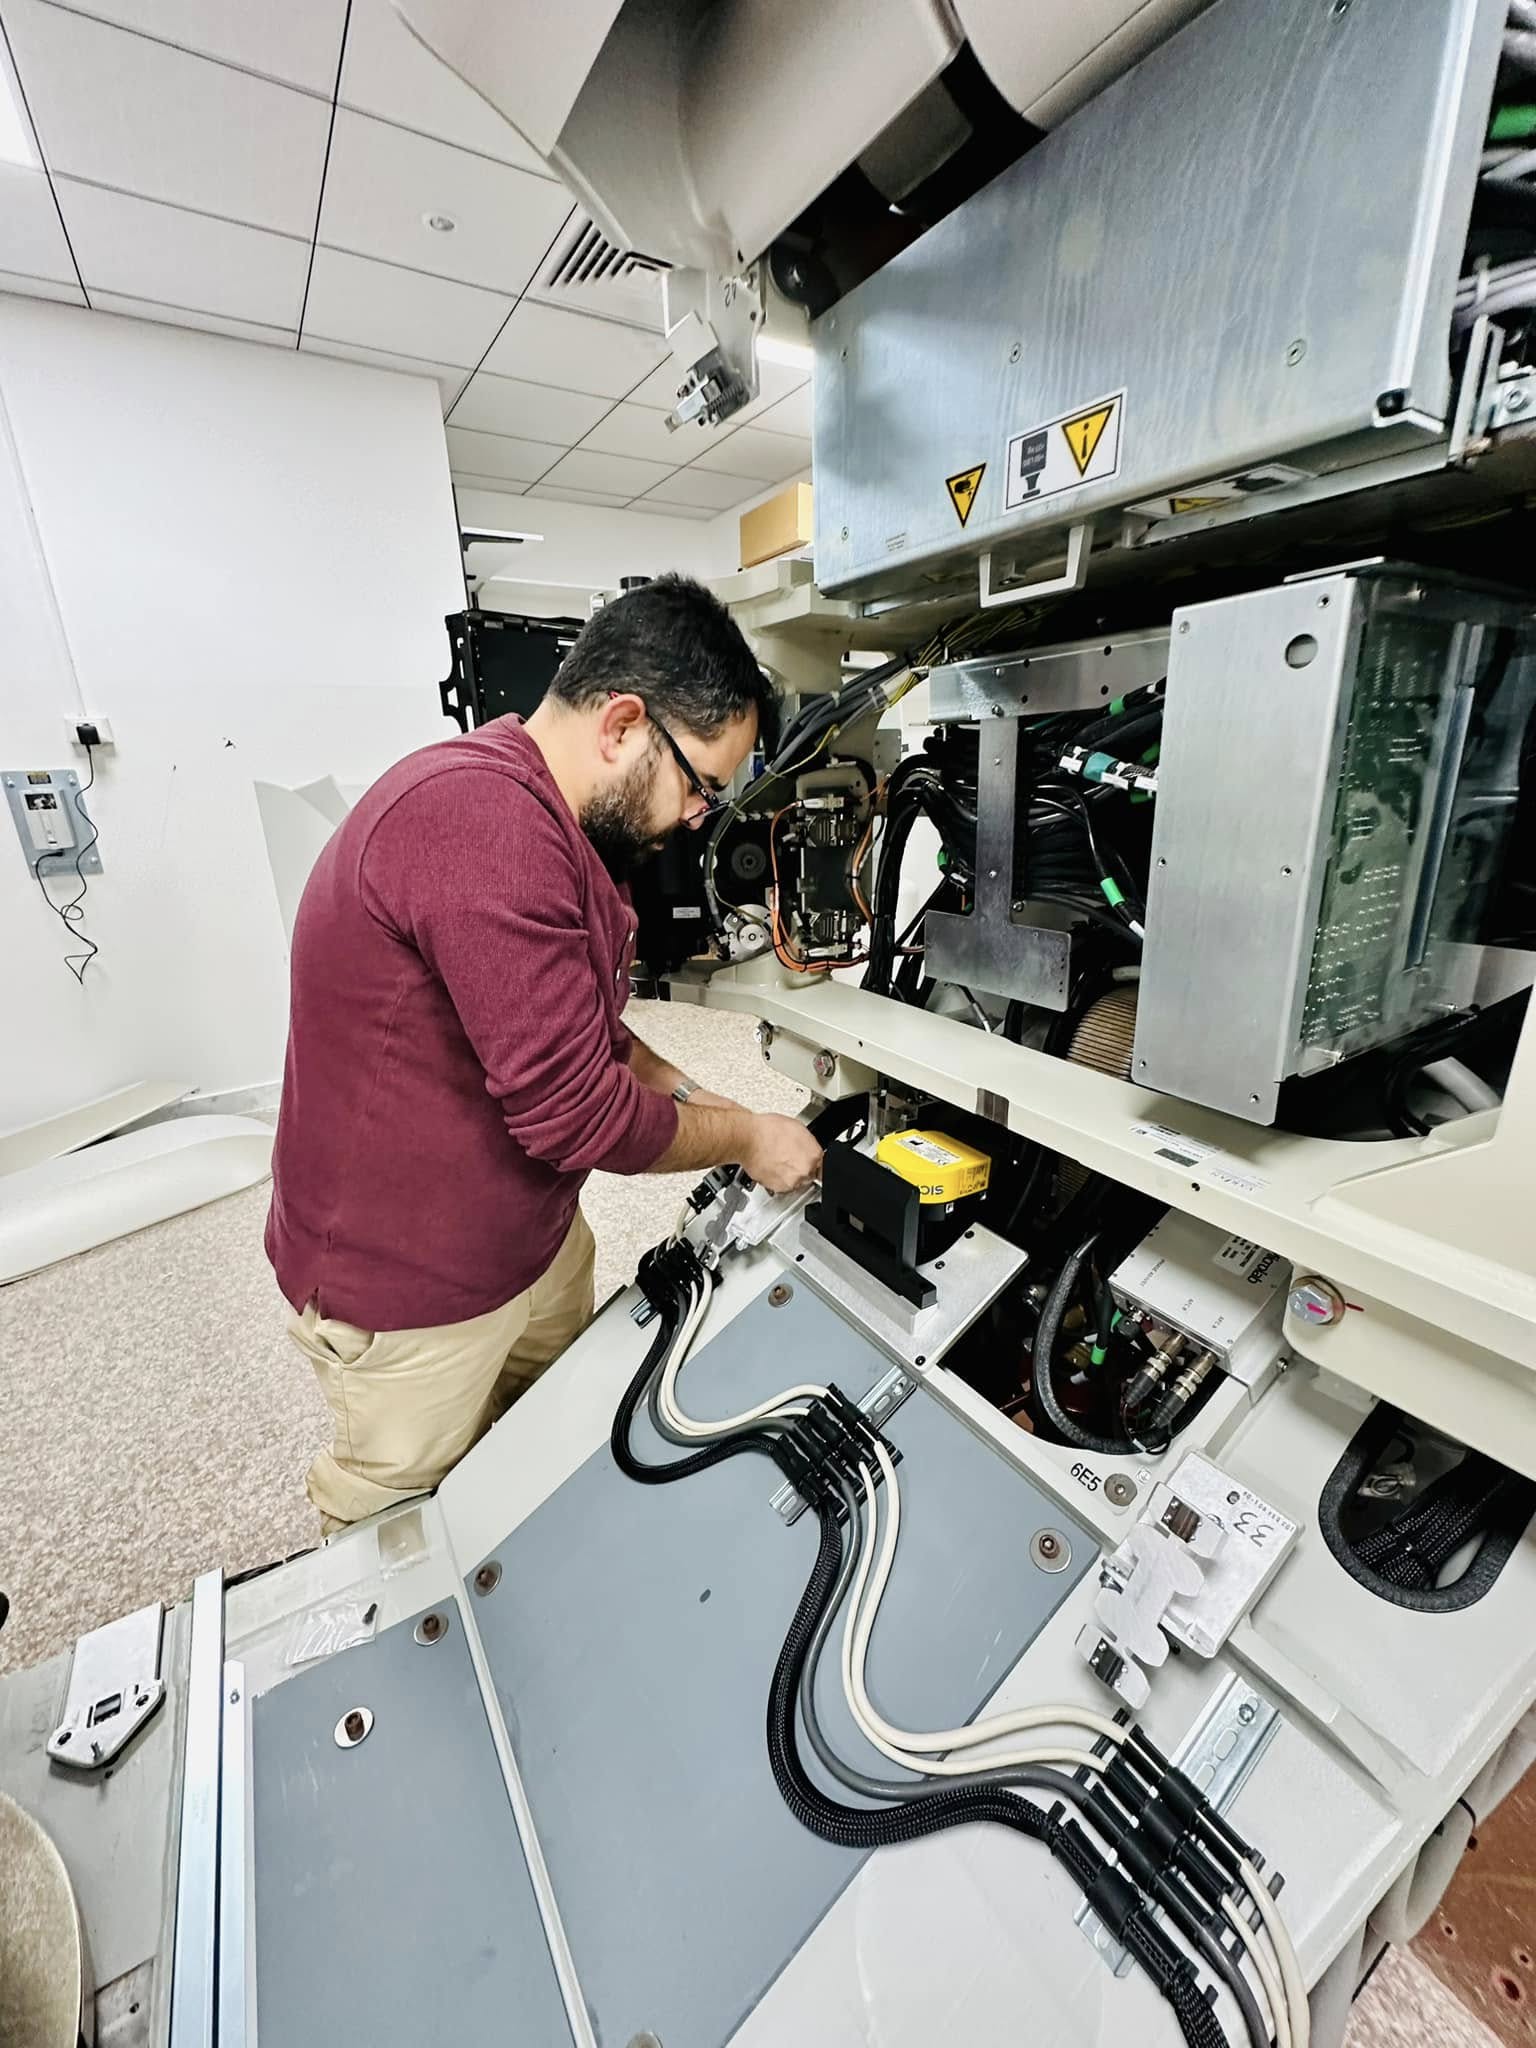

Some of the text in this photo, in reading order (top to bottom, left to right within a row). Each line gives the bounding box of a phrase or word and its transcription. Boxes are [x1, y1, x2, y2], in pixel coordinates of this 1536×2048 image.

[919, 1184, 944, 1196] SIC
[1070, 1462, 1102, 1492] 6E5
[1233, 1511, 1275, 1548] 33
